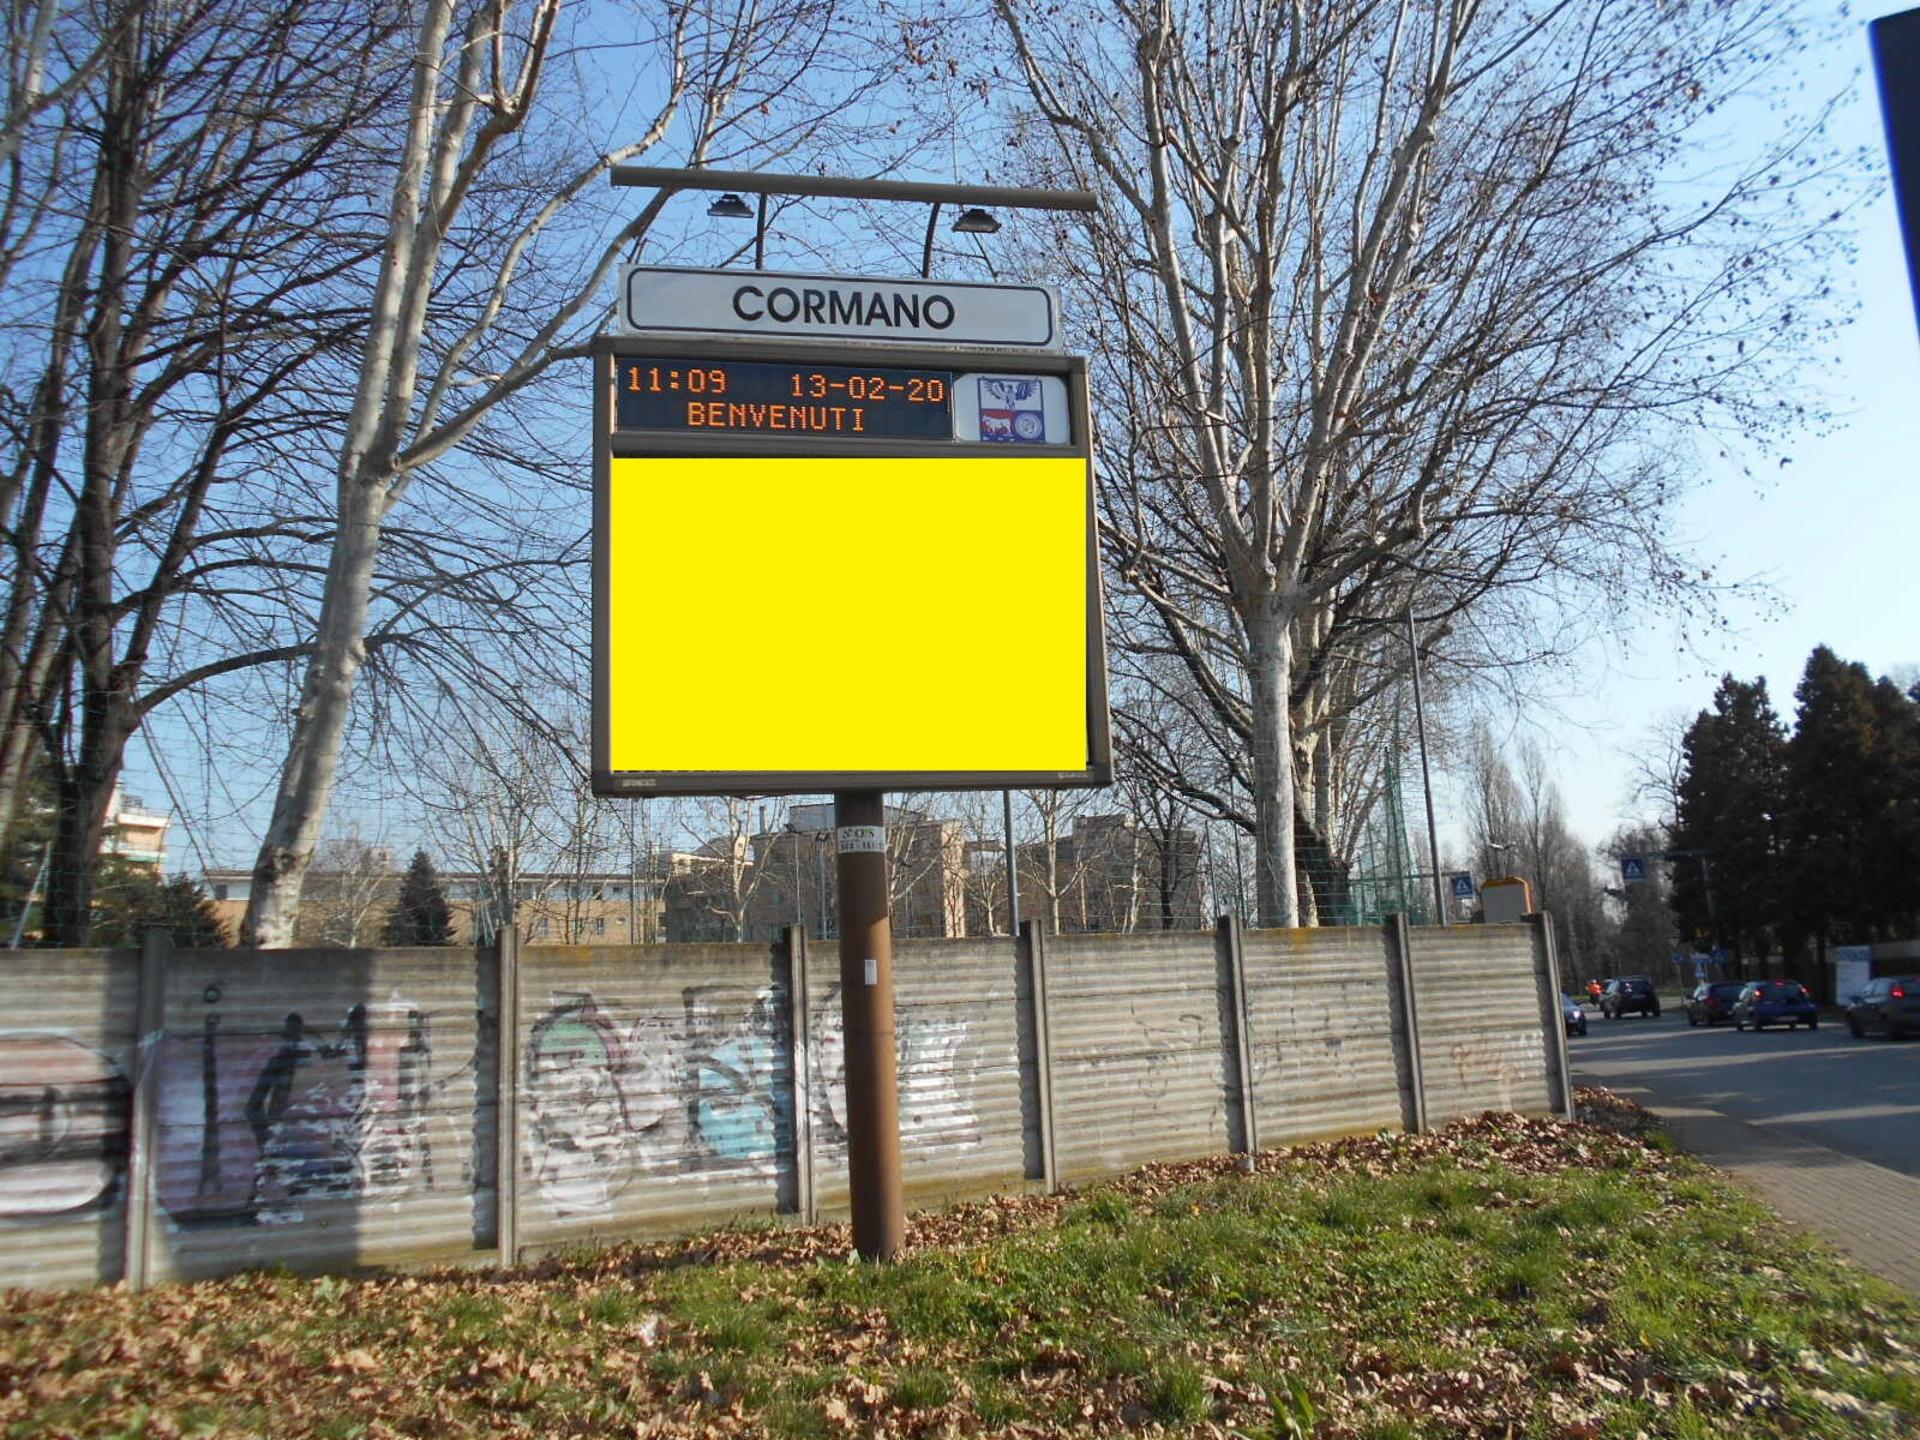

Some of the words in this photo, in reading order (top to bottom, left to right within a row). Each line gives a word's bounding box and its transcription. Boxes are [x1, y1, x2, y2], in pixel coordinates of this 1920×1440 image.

[732, 285, 955, 330] CORMANO
[628, 366, 727, 393] 11:09
[791, 373, 944, 402] 13-02-20
[687, 402, 865, 431] BENVENUTI
